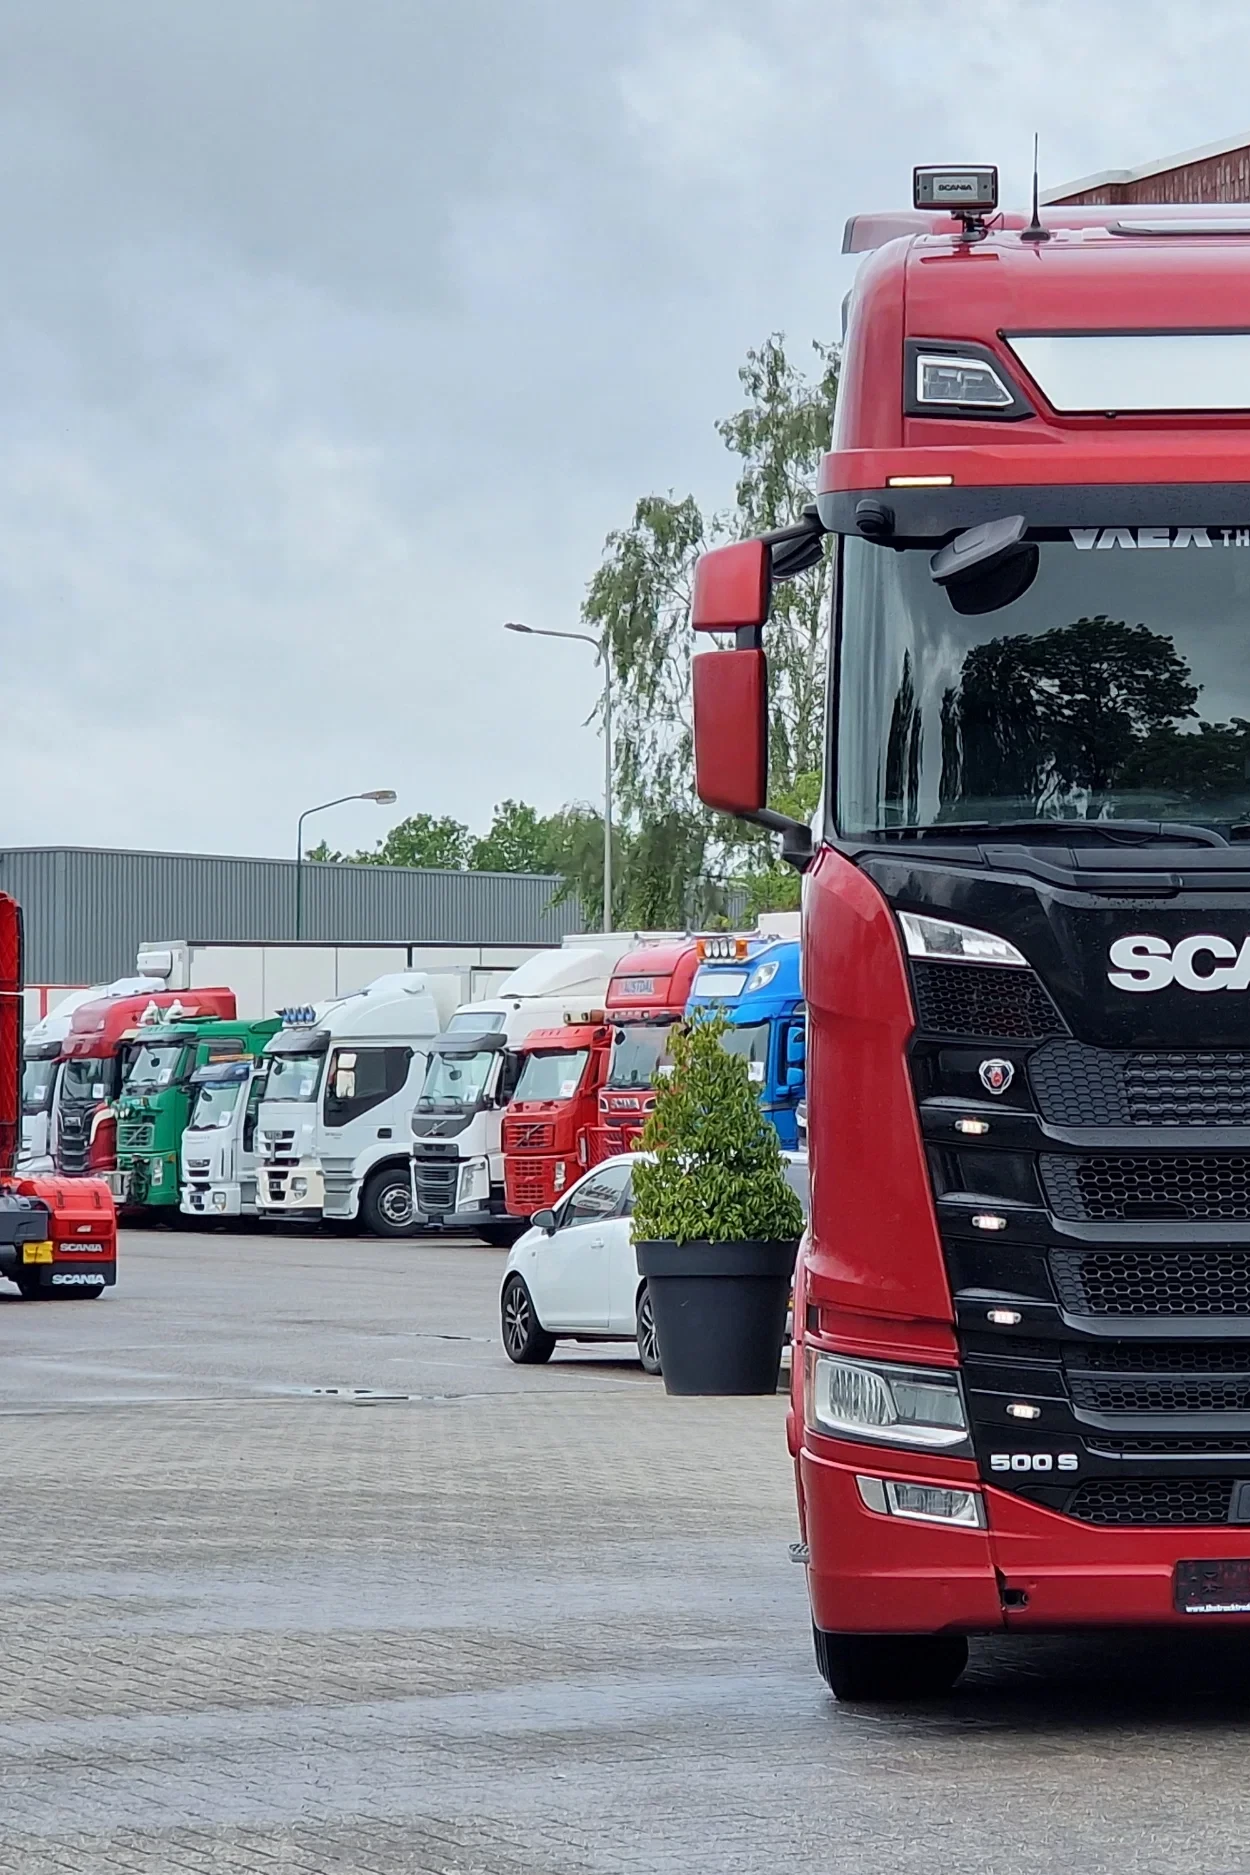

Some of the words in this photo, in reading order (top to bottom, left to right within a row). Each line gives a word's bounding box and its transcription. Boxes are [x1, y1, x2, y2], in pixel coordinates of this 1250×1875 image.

[60, 1243, 102, 1252] SCANIA
[52, 1274, 105, 1284] SCANIA
[990, 1454, 1052, 1471] 500
[1057, 1454, 1078, 1470] S
